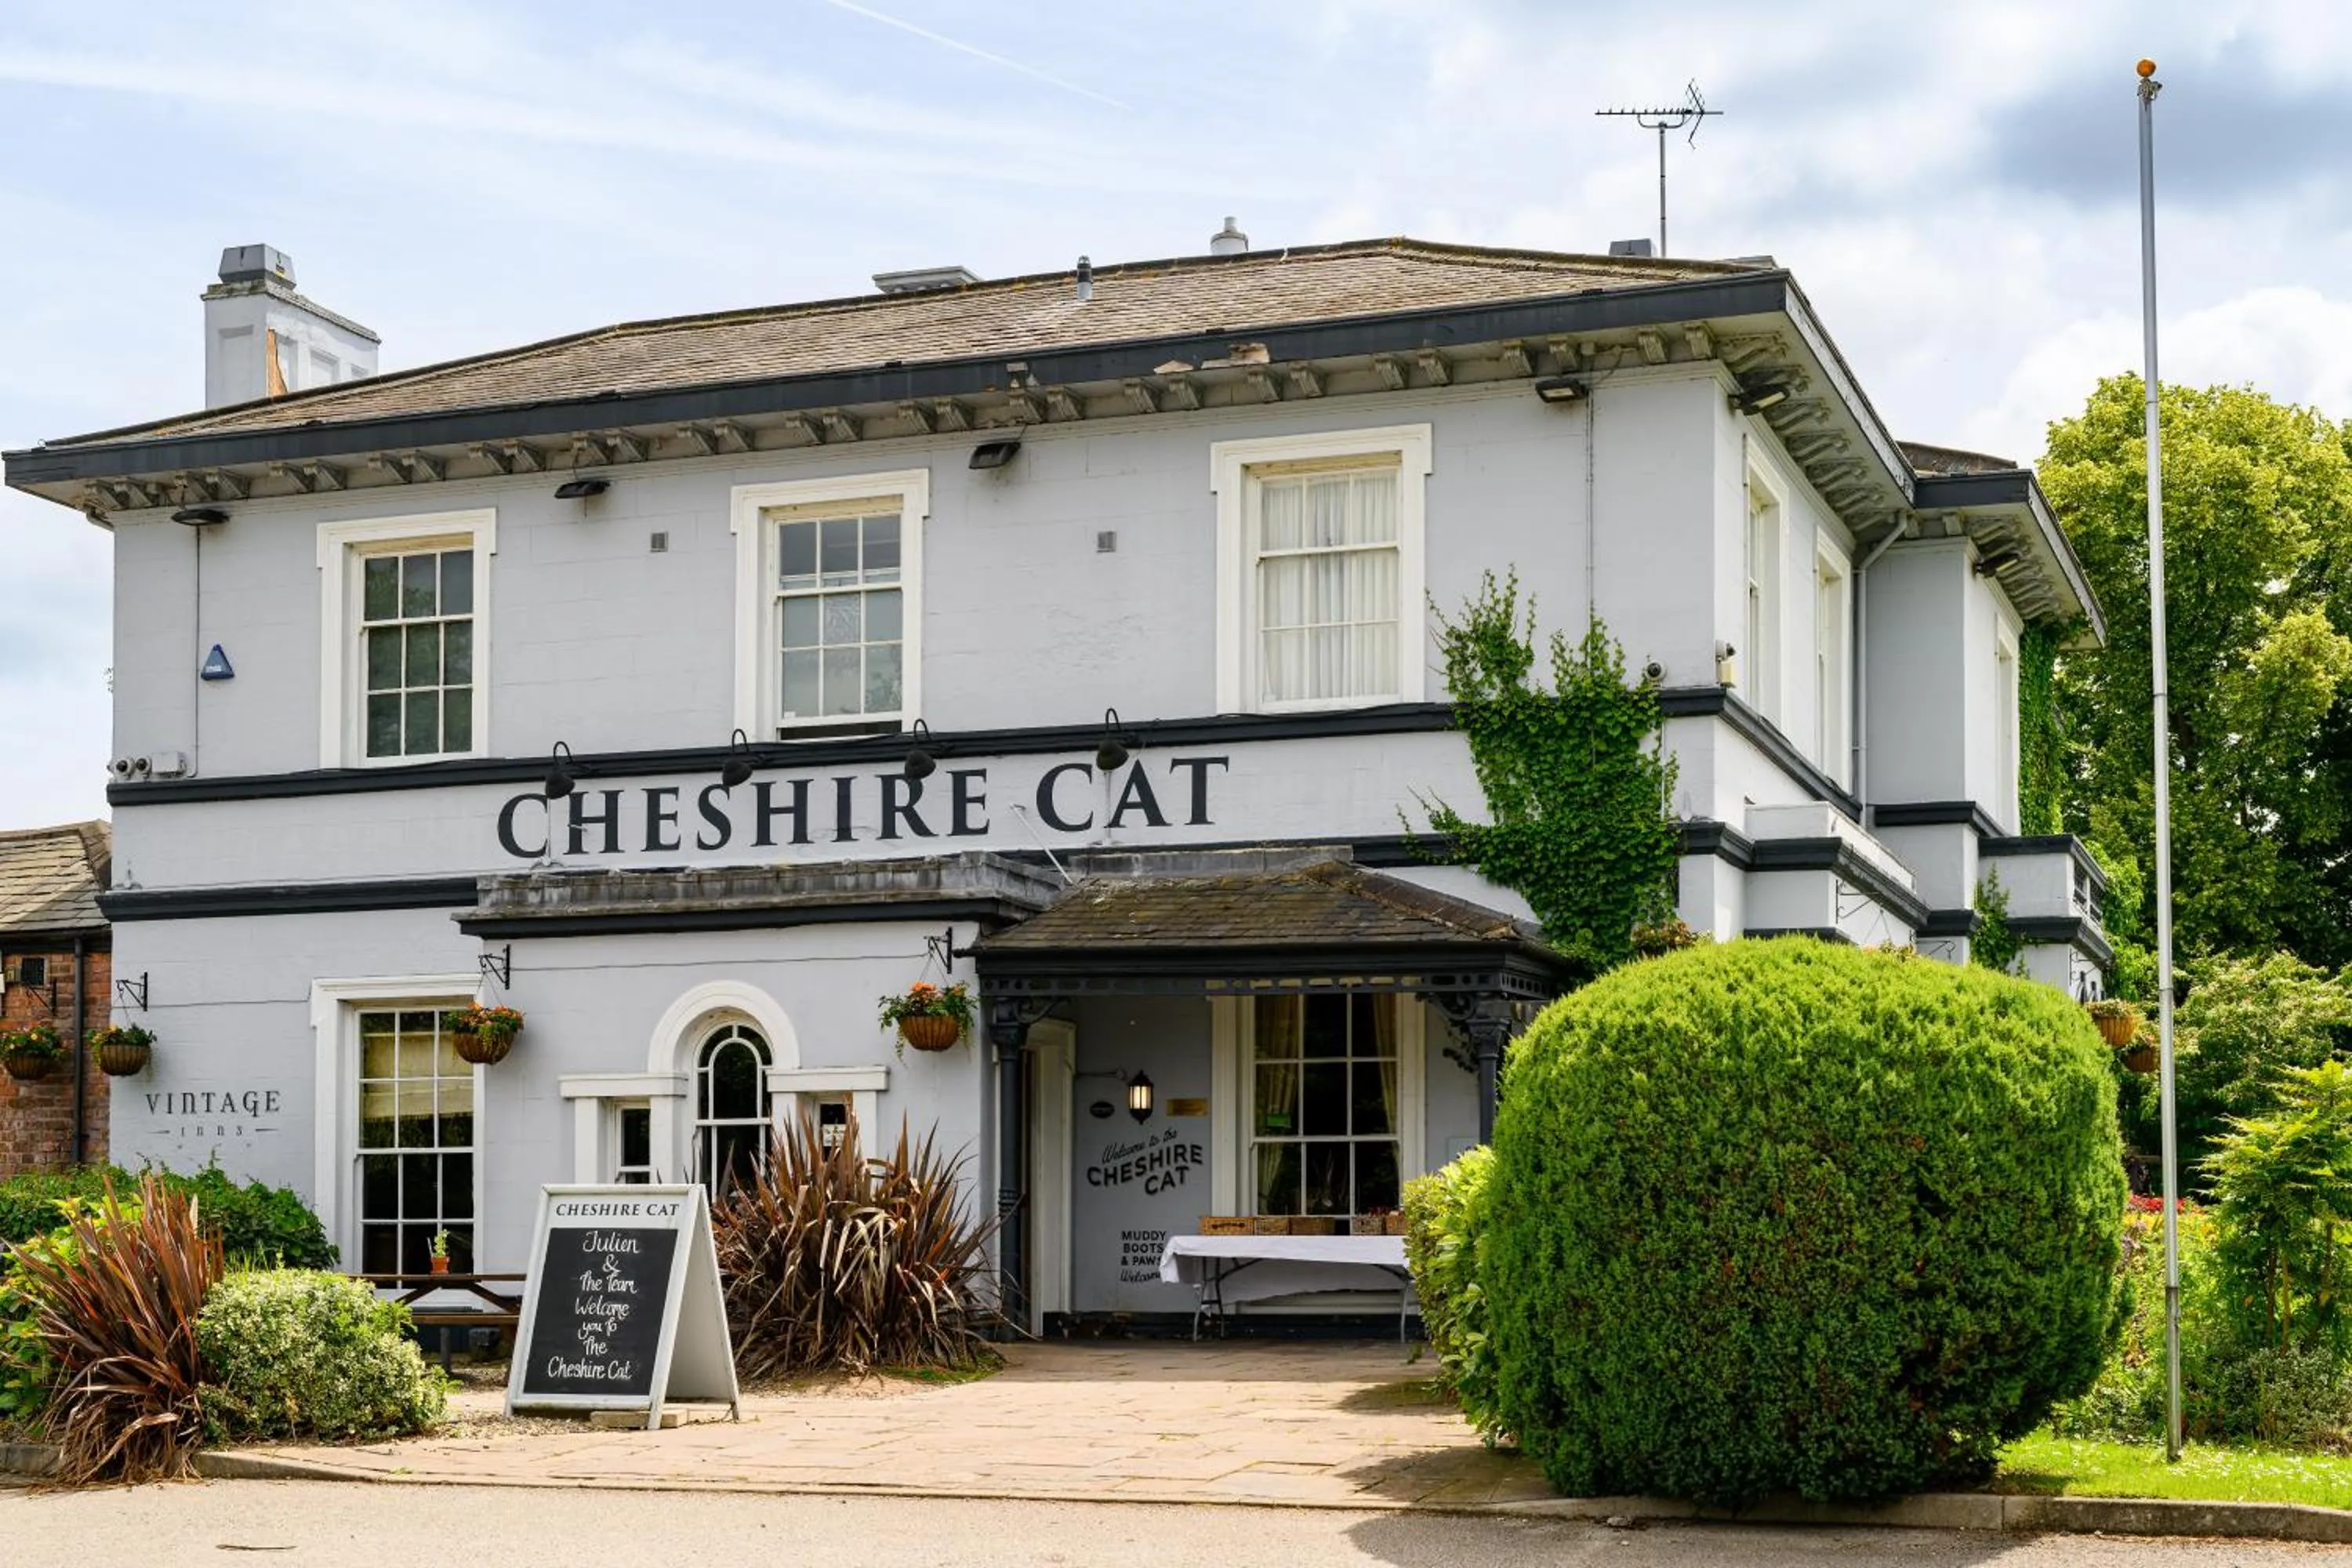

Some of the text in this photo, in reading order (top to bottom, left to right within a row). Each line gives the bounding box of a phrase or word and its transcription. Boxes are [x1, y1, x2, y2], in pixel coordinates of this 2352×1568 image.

[496, 757, 1230, 859] CHESHIRE CAT
[145, 1091, 281, 1117] VINTAGE
[1102, 1127, 1178, 1164] Welcome to the
[1087, 1144, 1203, 1187] CHESHIRE
[1145, 1165, 1189, 1196] CAT
[556, 1204, 680, 1216] CHESHIRE CAT
[583, 1230, 640, 1254] Julien
[1122, 1231, 1166, 1240] MUDDY
[1123, 1243, 1164, 1253] BOOTS
[602, 1254, 622, 1272] &
[575, 1294, 630, 1320] Welcome
[577, 1322, 602, 1340] you
[548, 1356, 633, 1380] Cheshire Cat
